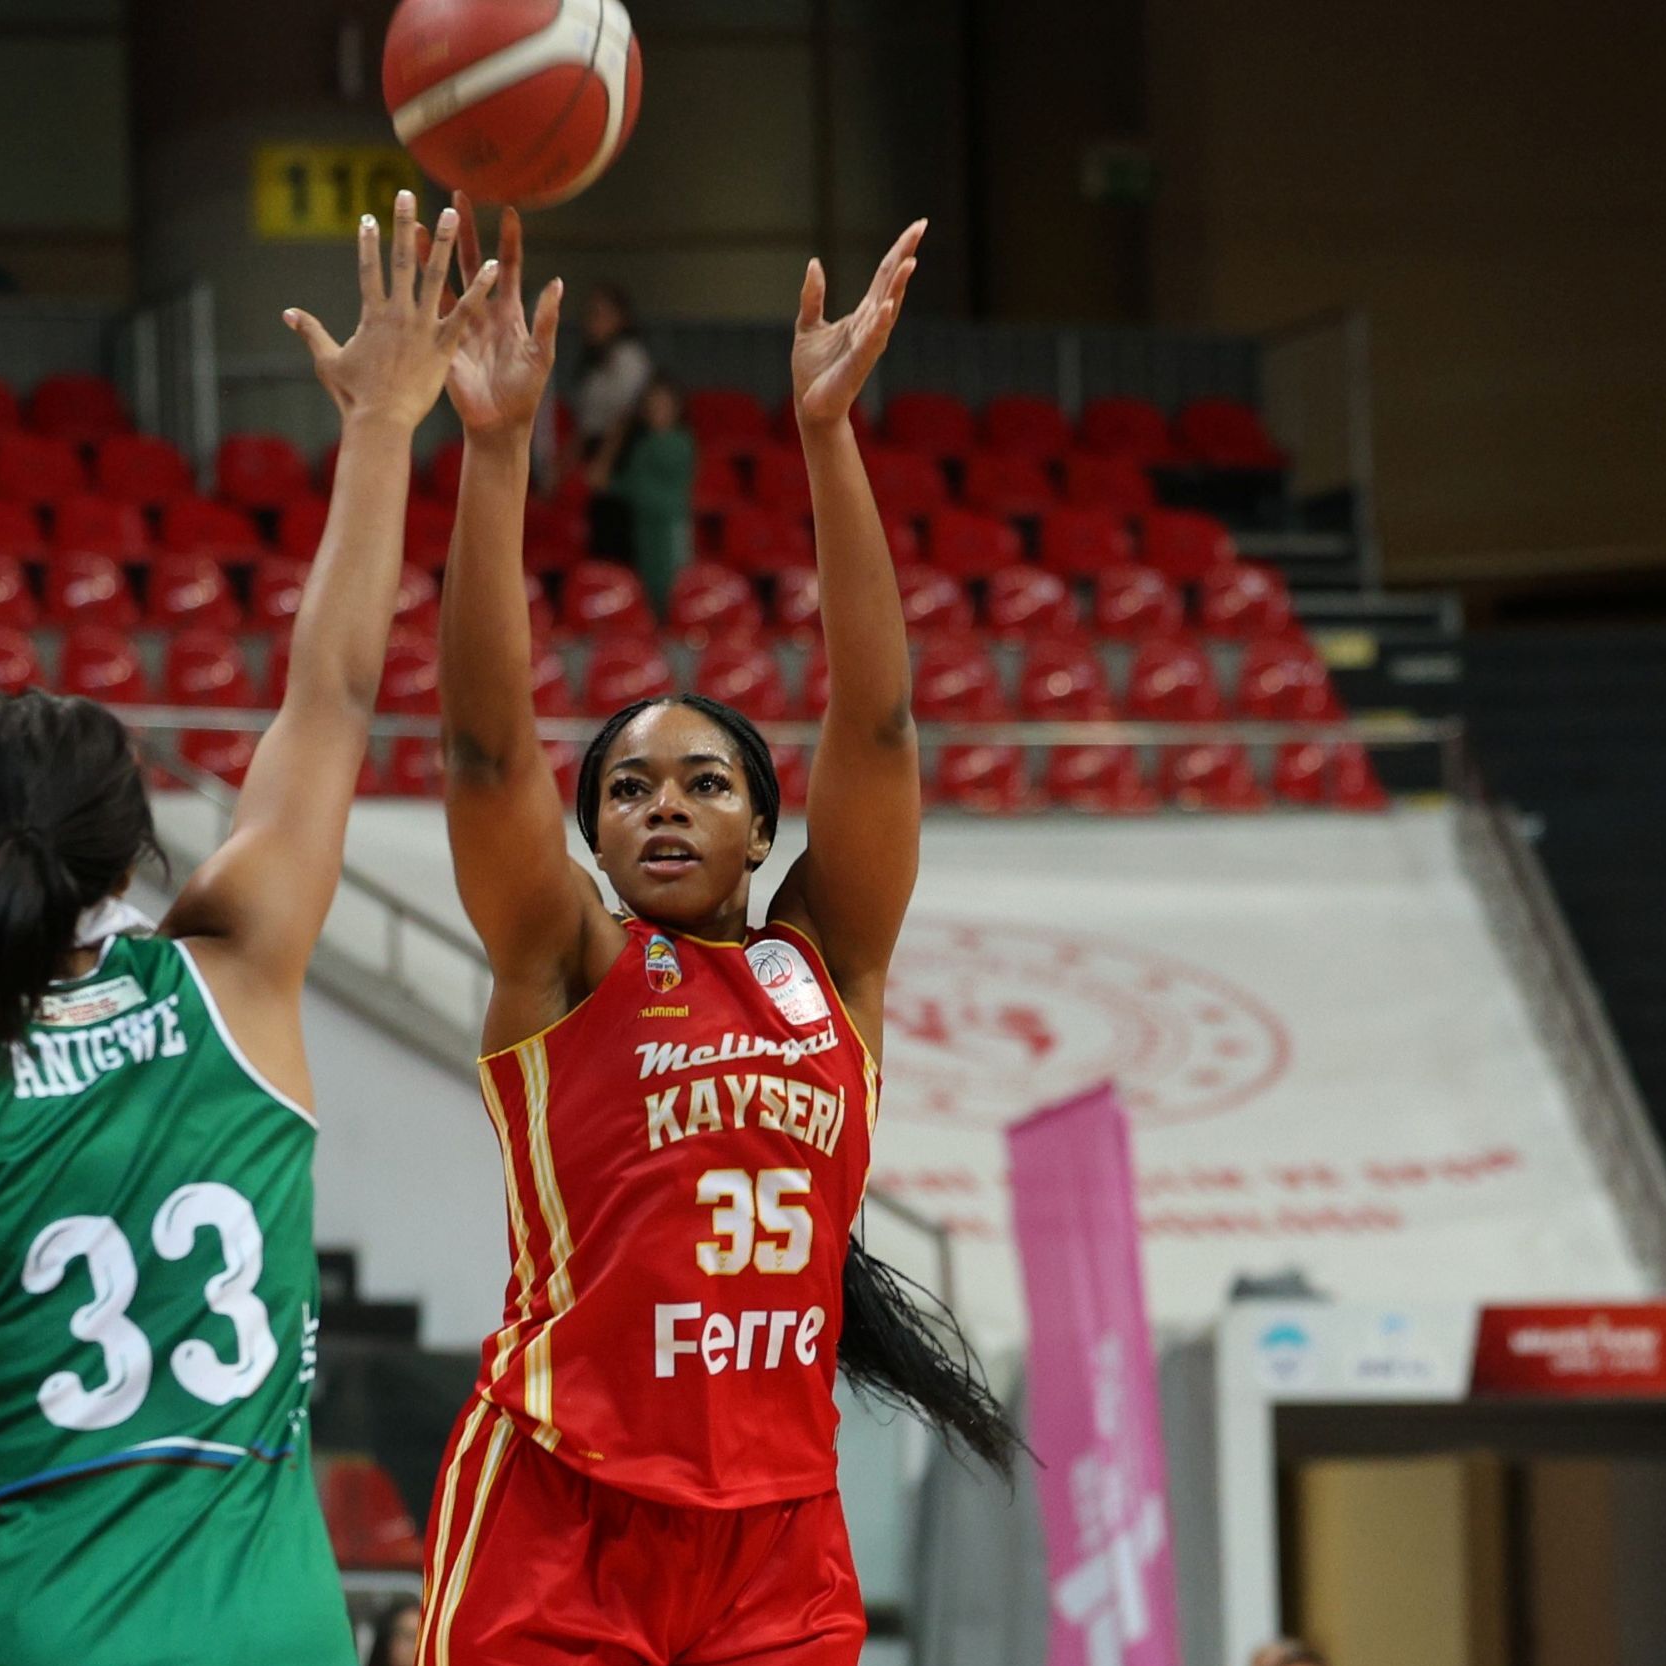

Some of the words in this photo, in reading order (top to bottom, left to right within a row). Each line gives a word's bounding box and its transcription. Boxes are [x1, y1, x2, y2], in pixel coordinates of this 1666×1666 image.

[10, 994, 188, 1099] ANIGWE
[645, 1074, 846, 1158] KAYSERİ
[695, 1168, 813, 1277] 35
[20, 1181, 279, 1431] 33
[654, 1301, 826, 1379] Ferre
